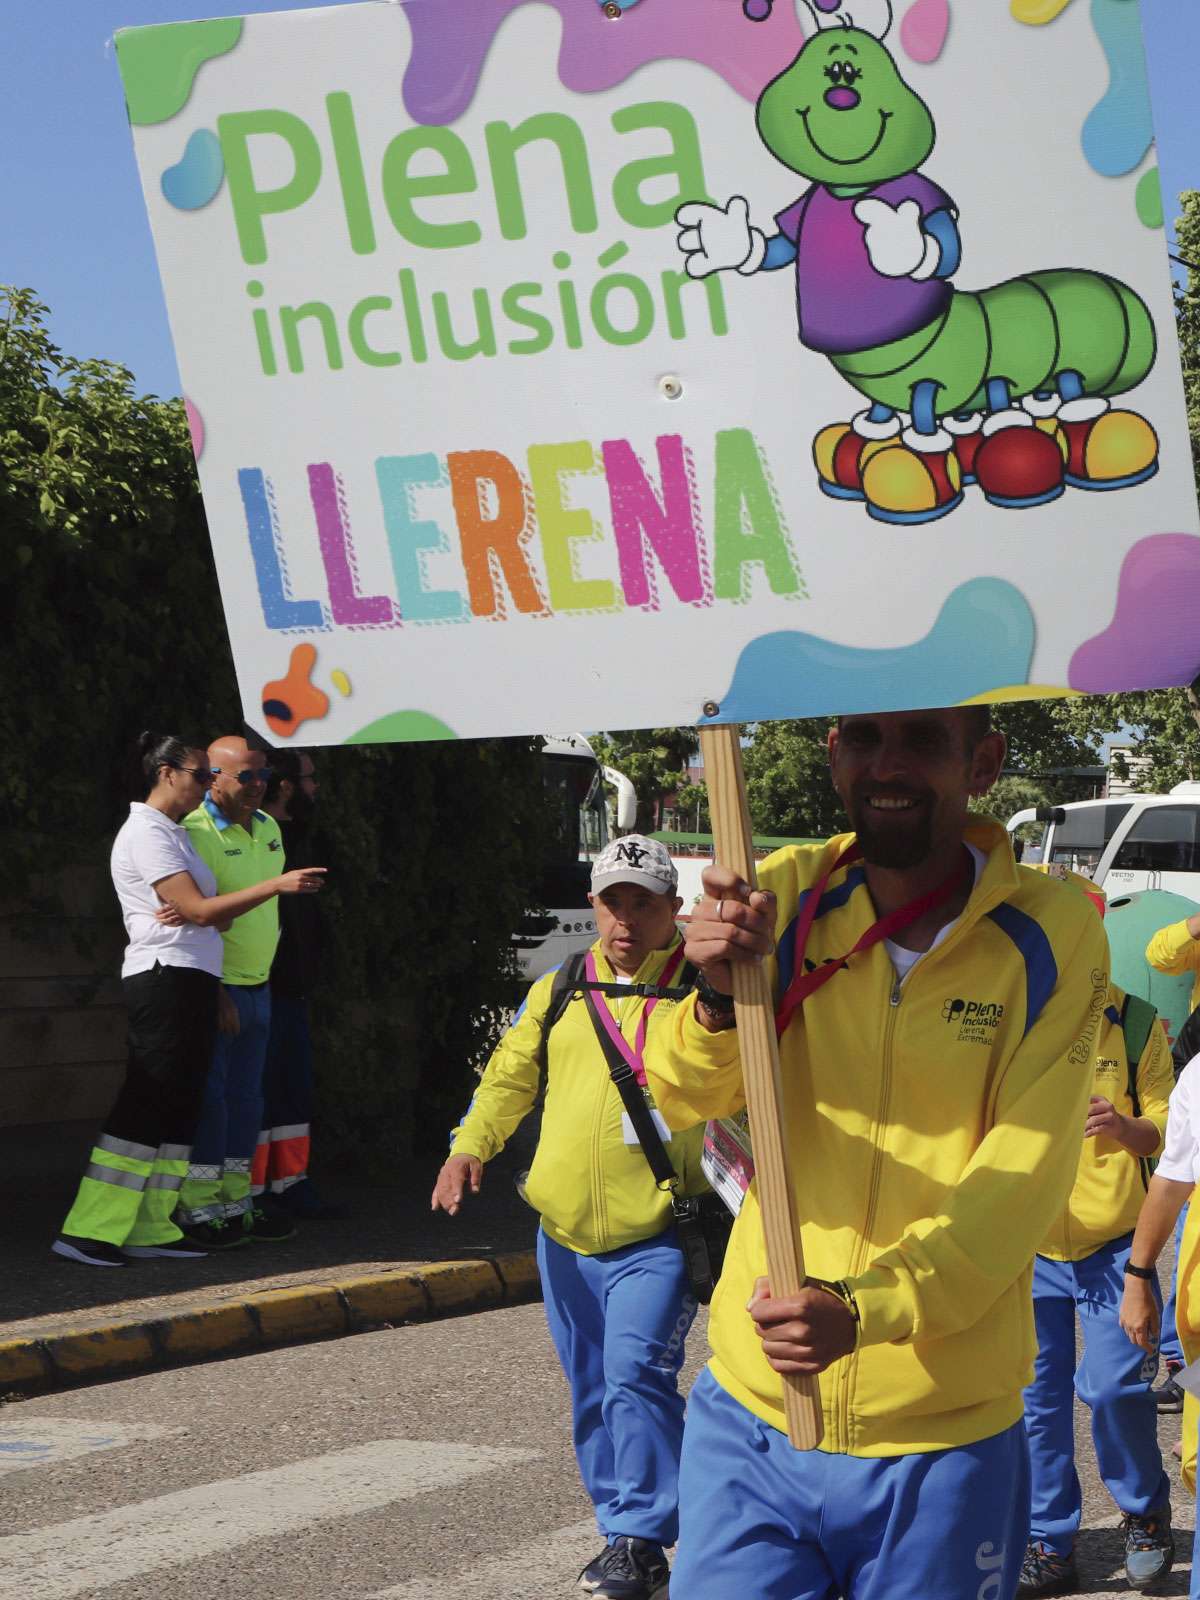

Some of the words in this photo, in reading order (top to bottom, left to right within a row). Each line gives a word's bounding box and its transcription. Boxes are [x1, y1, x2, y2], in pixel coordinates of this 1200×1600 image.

[217, 90, 714, 266] Plena
[246, 240, 729, 376] inclusión
[237, 428, 810, 634] LLERENA
[615, 842, 650, 868] NY
[966, 1002, 1005, 1018] Plena
